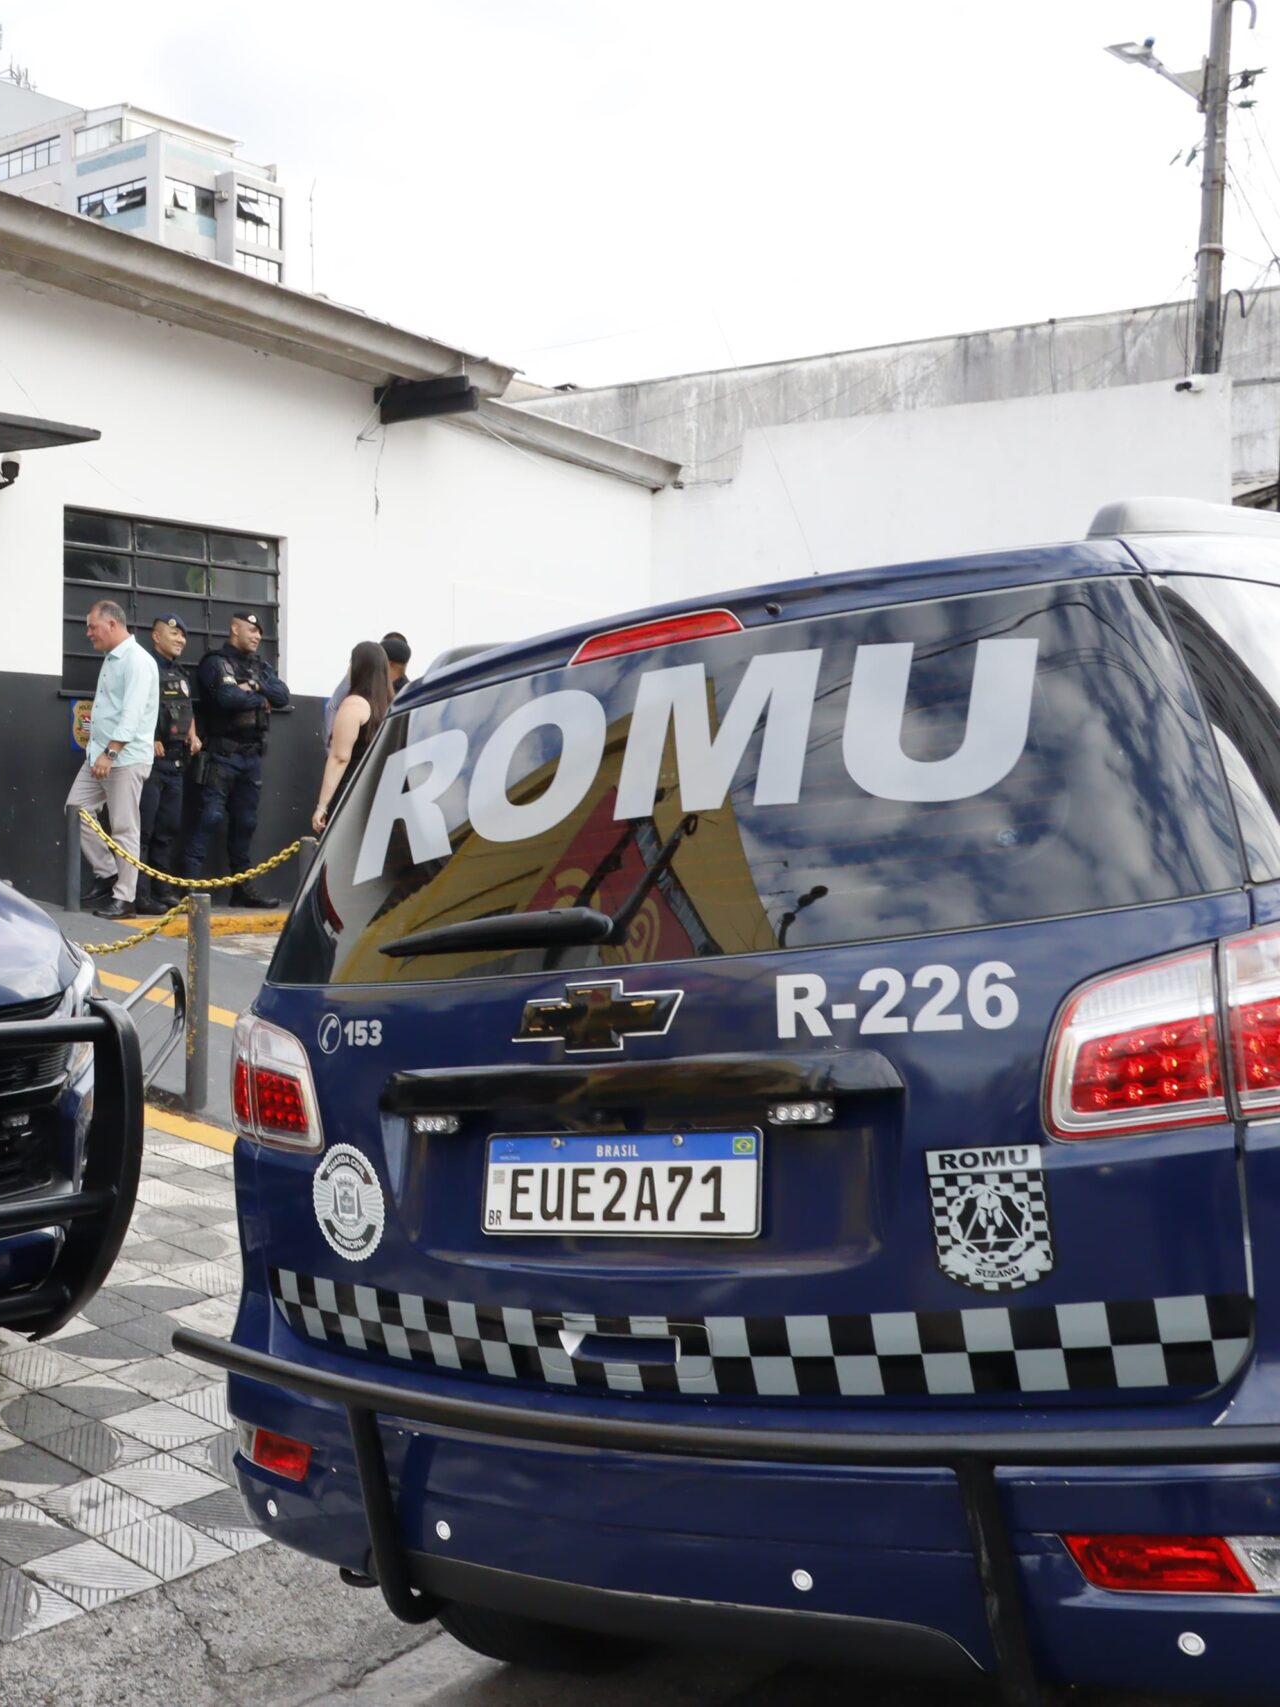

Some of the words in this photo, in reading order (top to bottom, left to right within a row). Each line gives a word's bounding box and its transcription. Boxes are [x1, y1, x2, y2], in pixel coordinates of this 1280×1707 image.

[352, 638, 1039, 885] ROMU
[776, 961, 1019, 1039] R-226
[344, 1019, 383, 1047] 153
[596, 1144, 639, 1158] BRASIL
[938, 1148, 1029, 1171] ROMU
[326, 1154, 350, 1174] GUARDA
[509, 1166, 726, 1222] EUE2A71
[488, 1210, 502, 1226] BR
[334, 1231, 367, 1249] MUNICIPAL
[975, 1265, 1020, 1278] SUZANO
